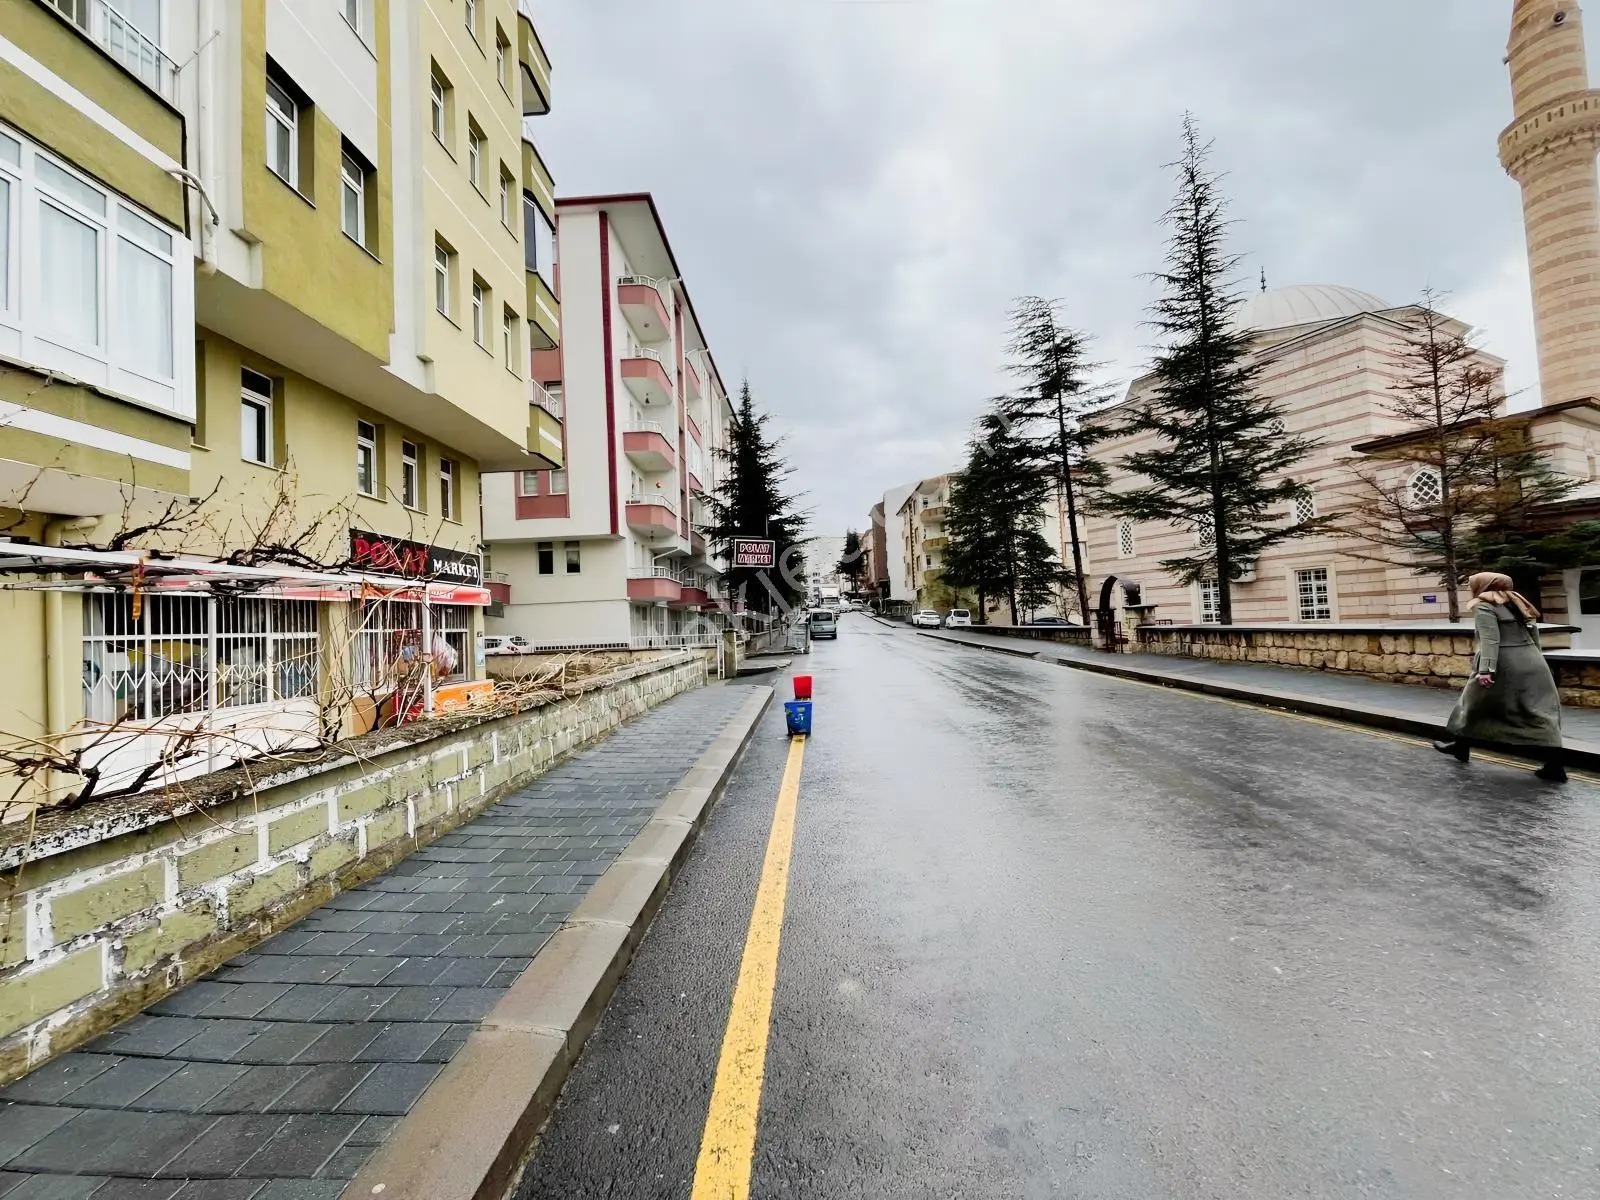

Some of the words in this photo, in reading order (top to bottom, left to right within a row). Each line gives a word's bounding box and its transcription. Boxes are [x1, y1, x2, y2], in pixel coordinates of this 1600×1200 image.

[740, 543, 770, 553] POLAT
[738, 554, 771, 564] MARKET
[433, 558, 478, 578] MARKET
